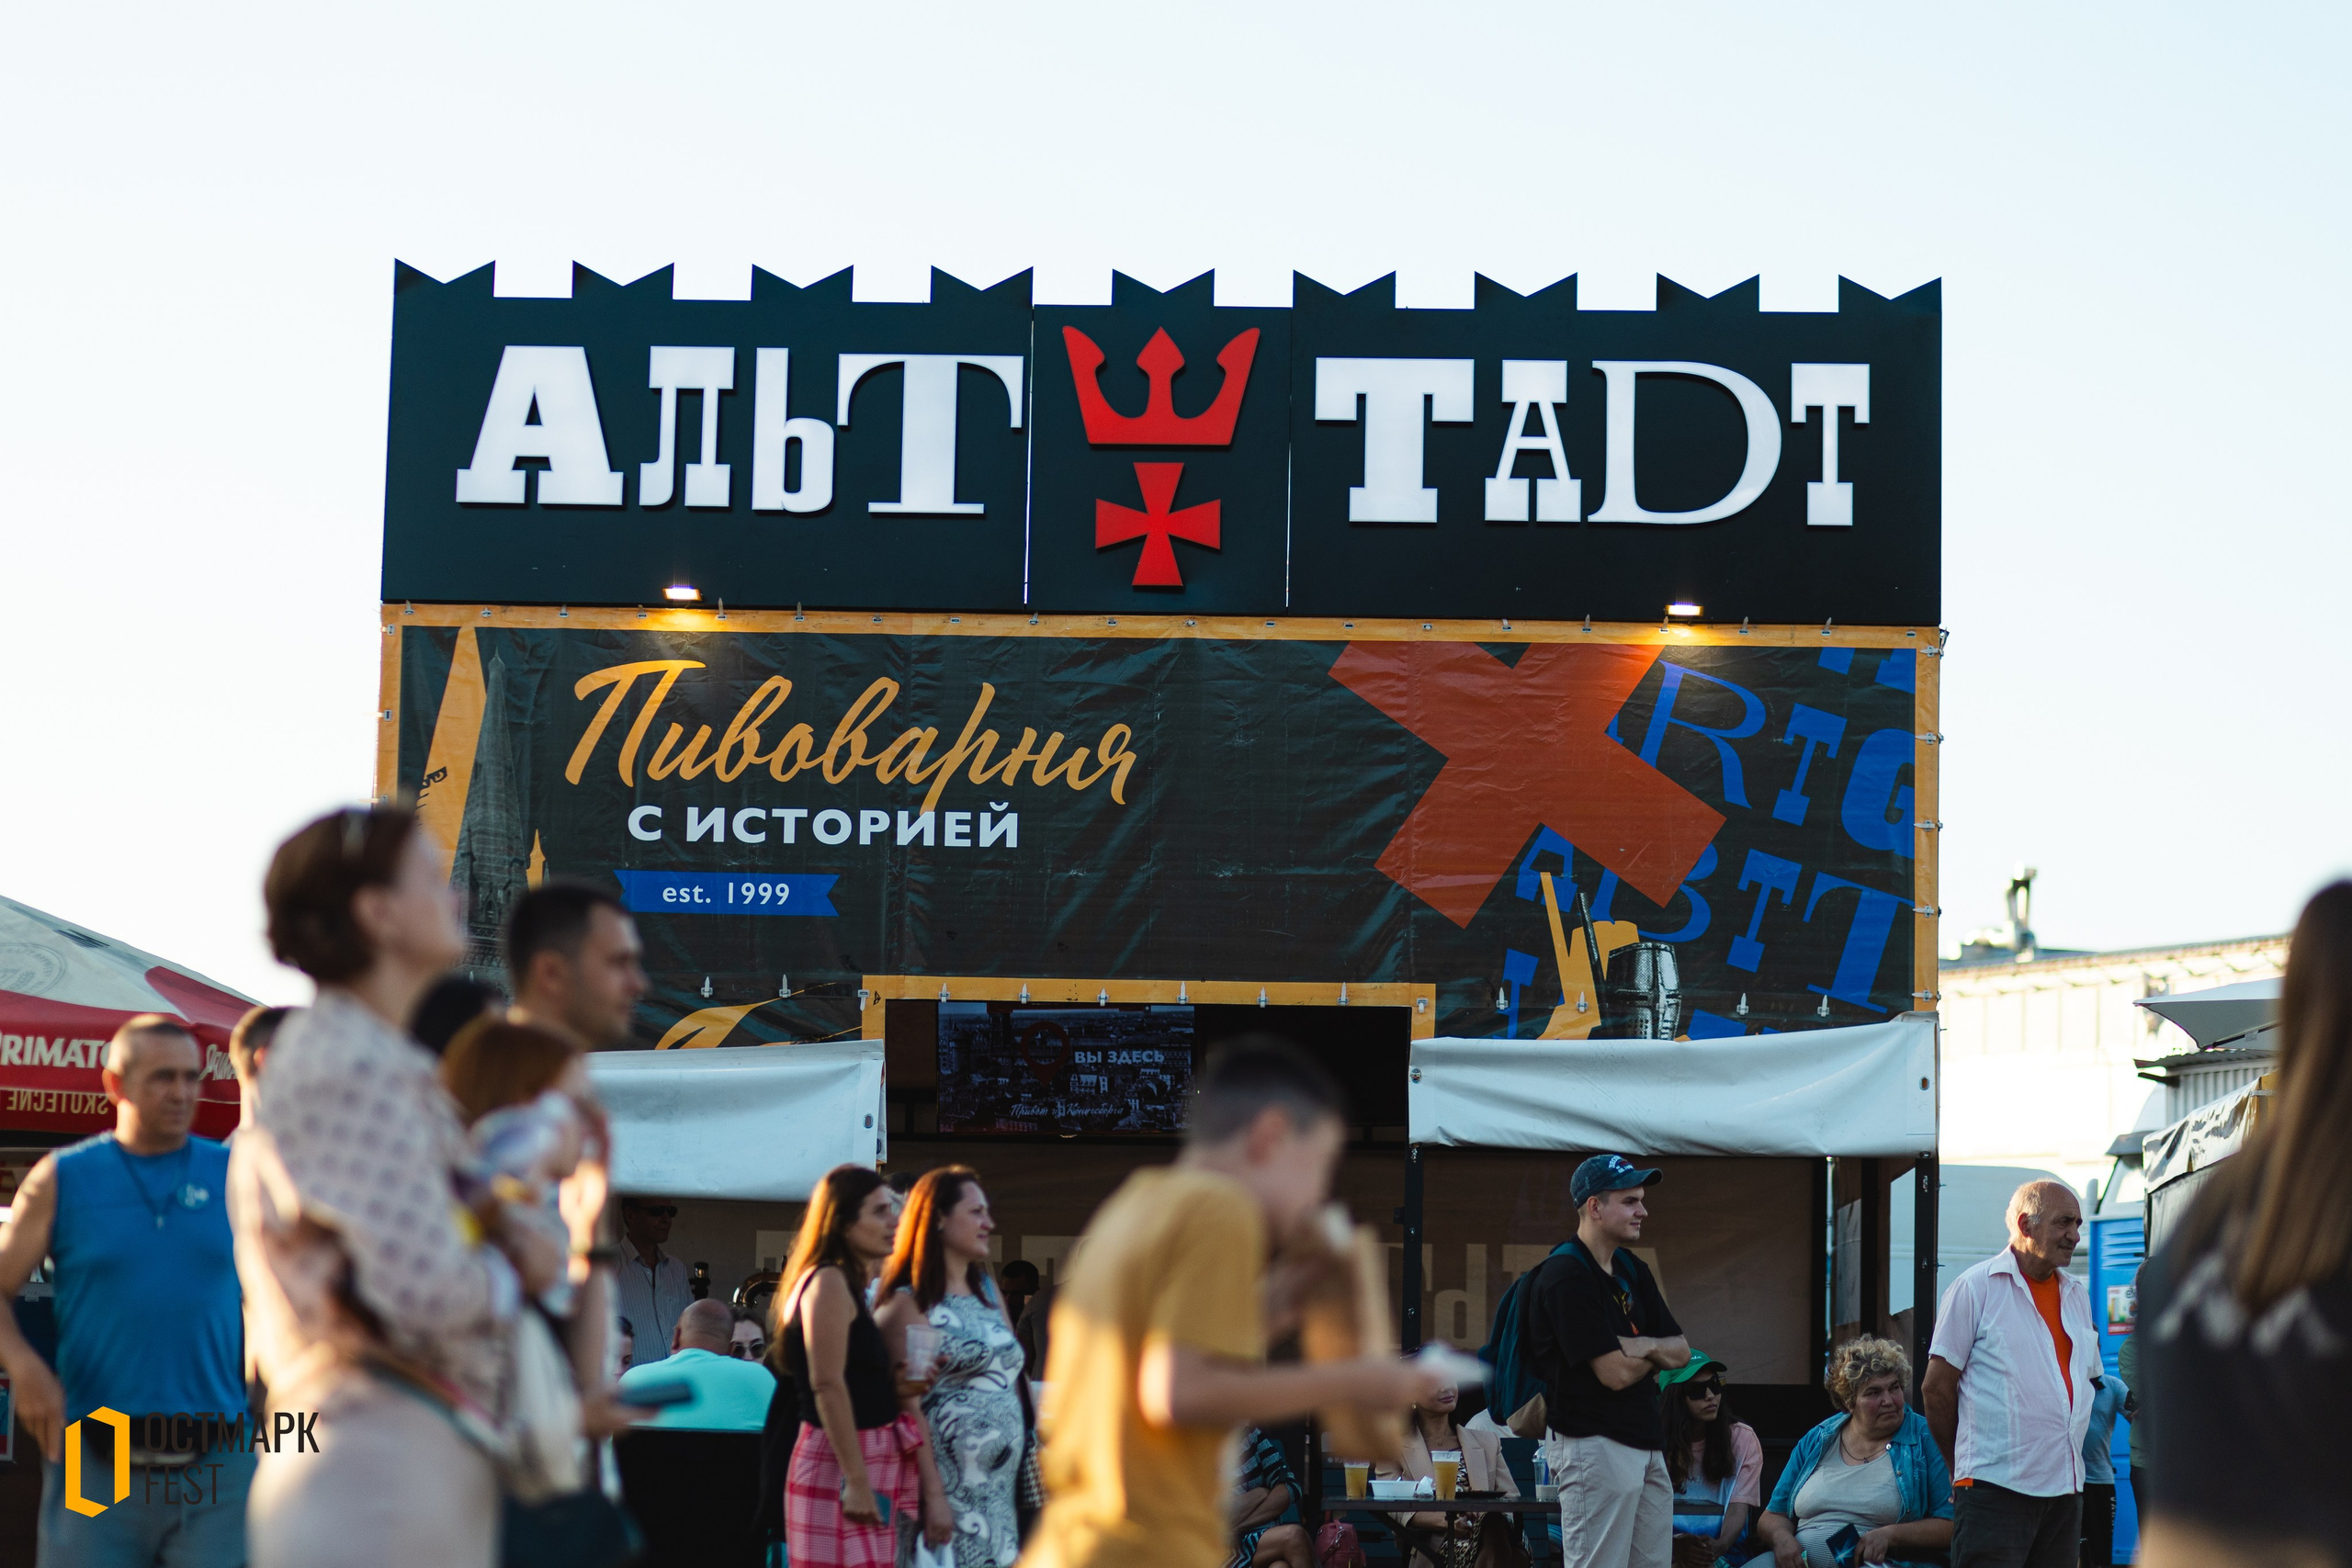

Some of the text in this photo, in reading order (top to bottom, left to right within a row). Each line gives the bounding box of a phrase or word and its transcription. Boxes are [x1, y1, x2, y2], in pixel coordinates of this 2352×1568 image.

[564, 659, 1137, 815] Пивоварня
[628, 801, 1020, 850] С ИСТОРИЕЙ
[662, 881, 791, 906] est. 1999
[0, 1030, 111, 1069] RIMAT
[1074, 1050, 1165, 1065] ВЫ ЗДЕСЬ
